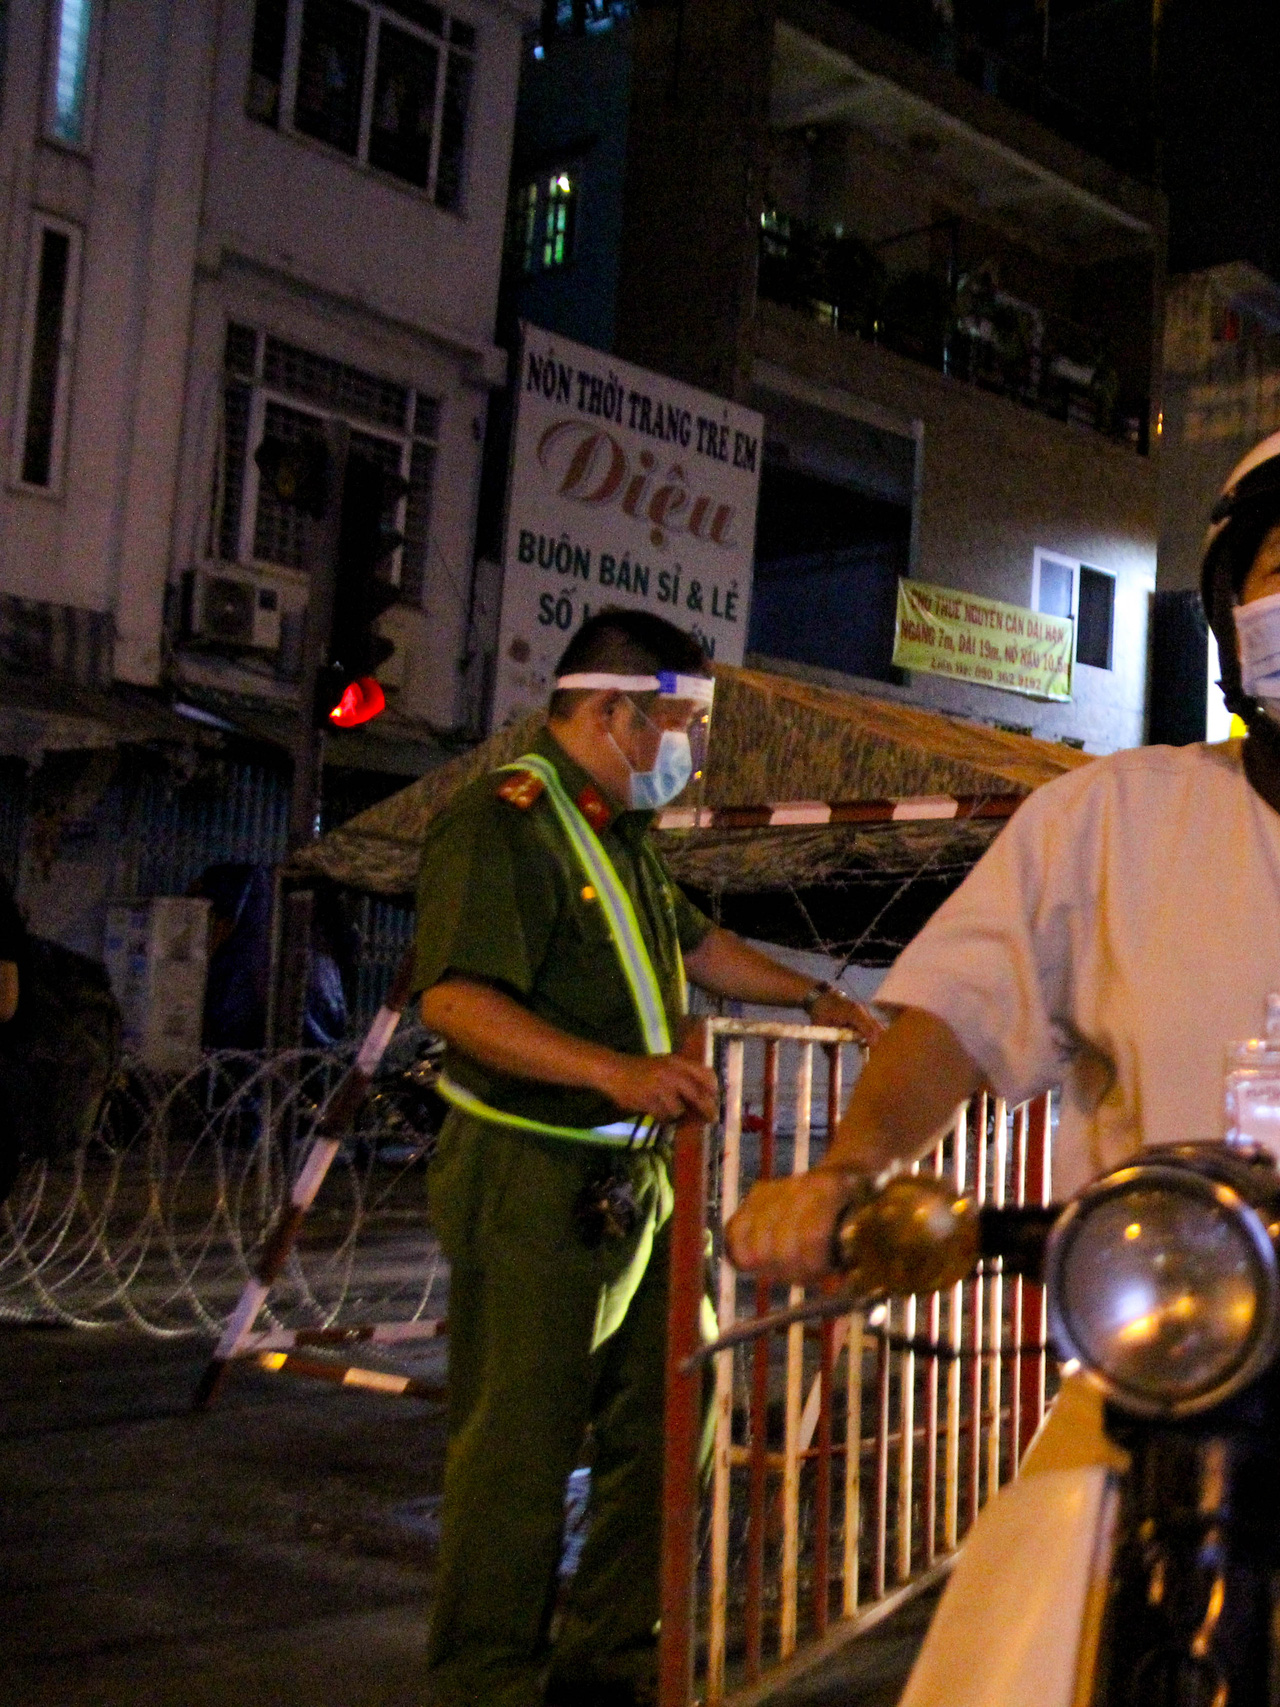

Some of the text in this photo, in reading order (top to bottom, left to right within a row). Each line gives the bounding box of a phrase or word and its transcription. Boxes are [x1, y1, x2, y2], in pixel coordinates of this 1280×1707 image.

[577, 369, 624, 423] THỜI
[628, 389, 692, 448] TRANG
[696, 407, 730, 462] TRẺ
[733, 429, 758, 473] EM
[536, 417, 738, 548] Diệu
[518, 529, 740, 622] BUÔN BÁN SỈ & LẺ
[537, 587, 577, 630] SỐ
